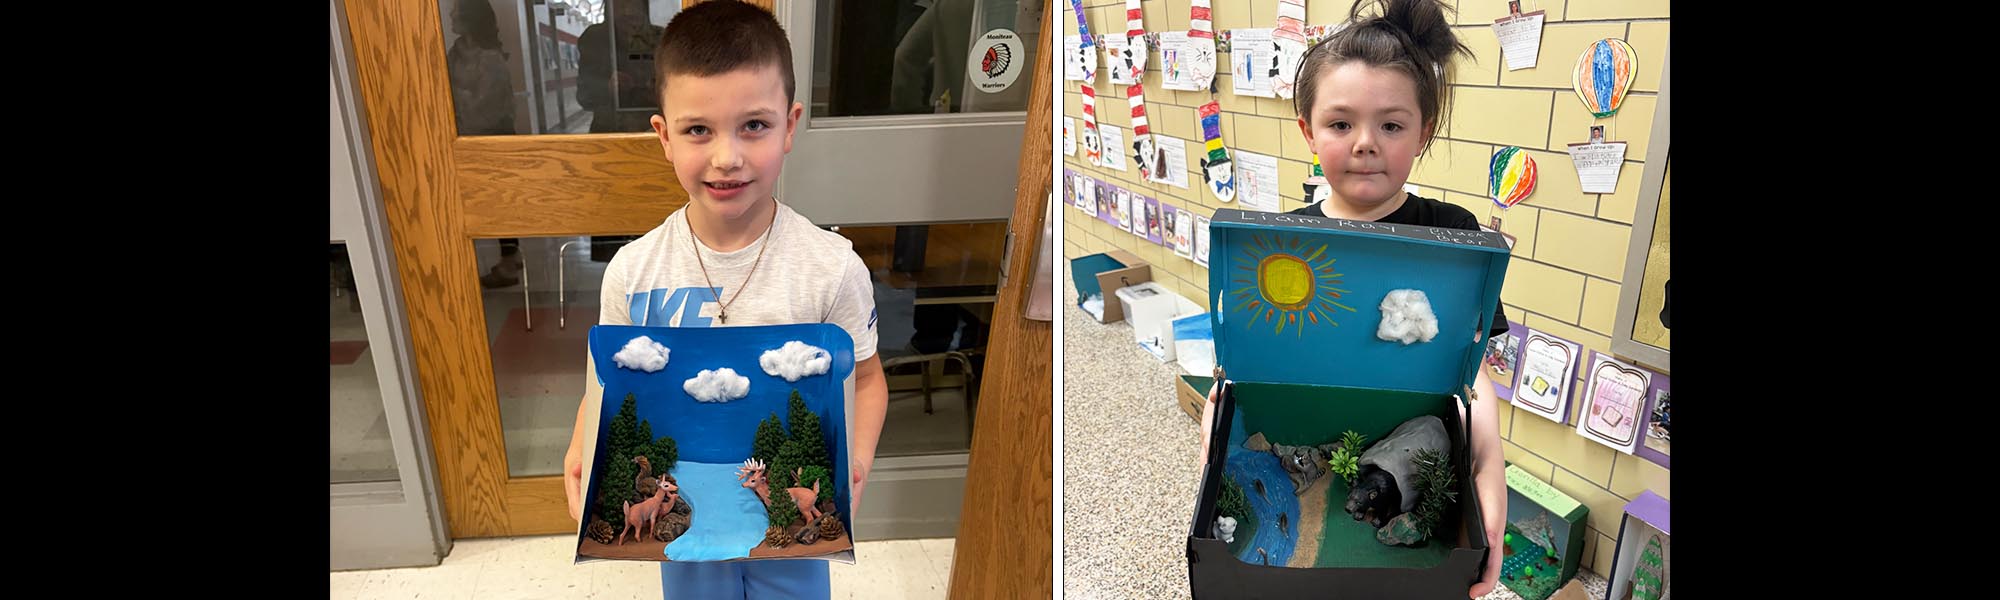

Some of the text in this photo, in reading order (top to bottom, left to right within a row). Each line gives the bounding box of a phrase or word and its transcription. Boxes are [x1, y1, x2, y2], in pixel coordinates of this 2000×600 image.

[1241, 211, 1321, 225] Liam
[1429, 227, 1489, 241] Black
[1435, 234, 1488, 246] Bear
